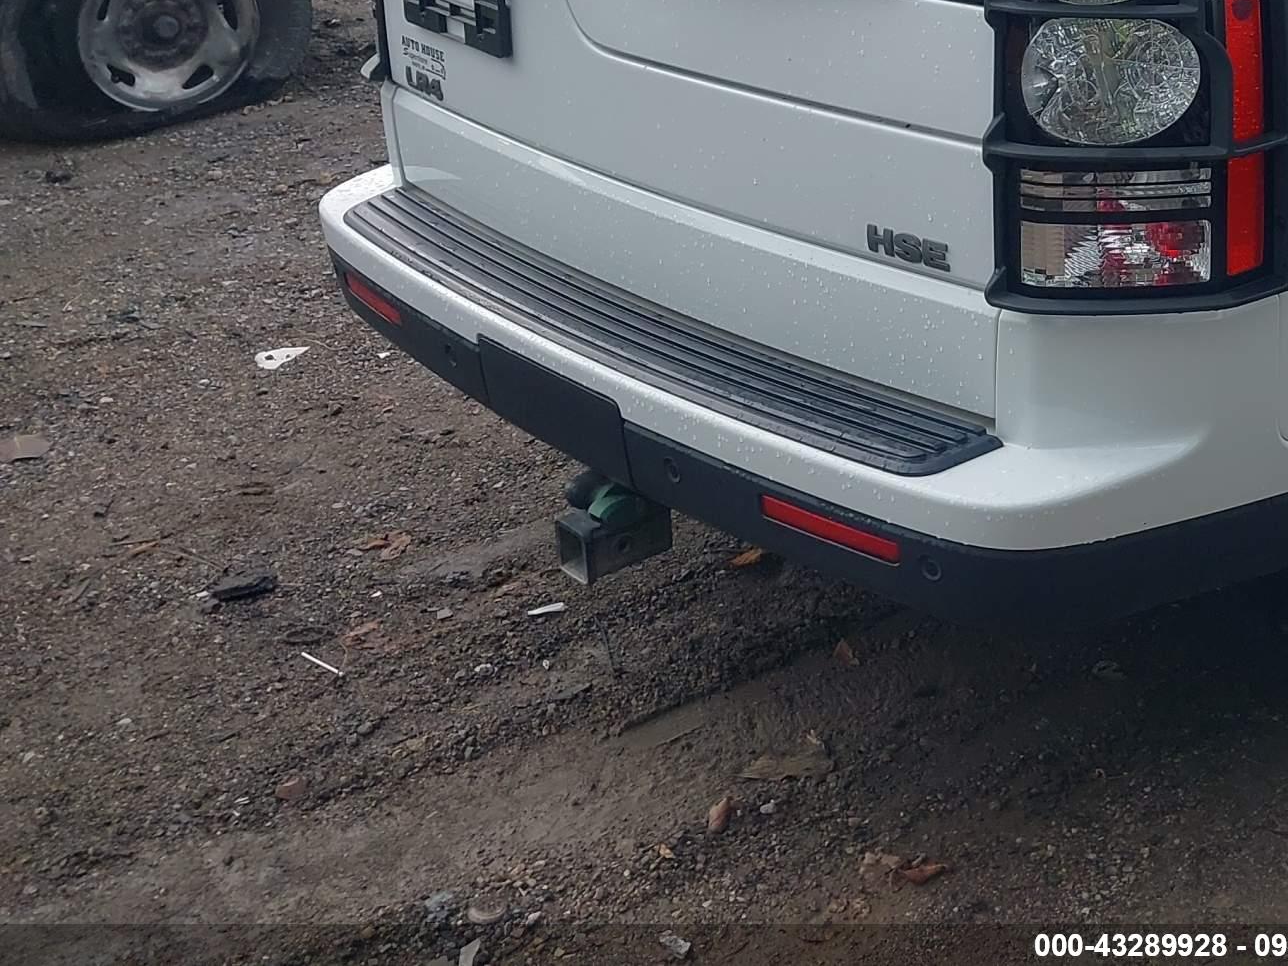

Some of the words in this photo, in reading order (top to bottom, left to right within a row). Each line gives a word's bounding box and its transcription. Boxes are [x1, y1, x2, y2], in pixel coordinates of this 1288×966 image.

[401, 35, 420, 52] AUTO
[420, 42, 445, 63] HOUSE
[866, 223, 951, 273] HSE
